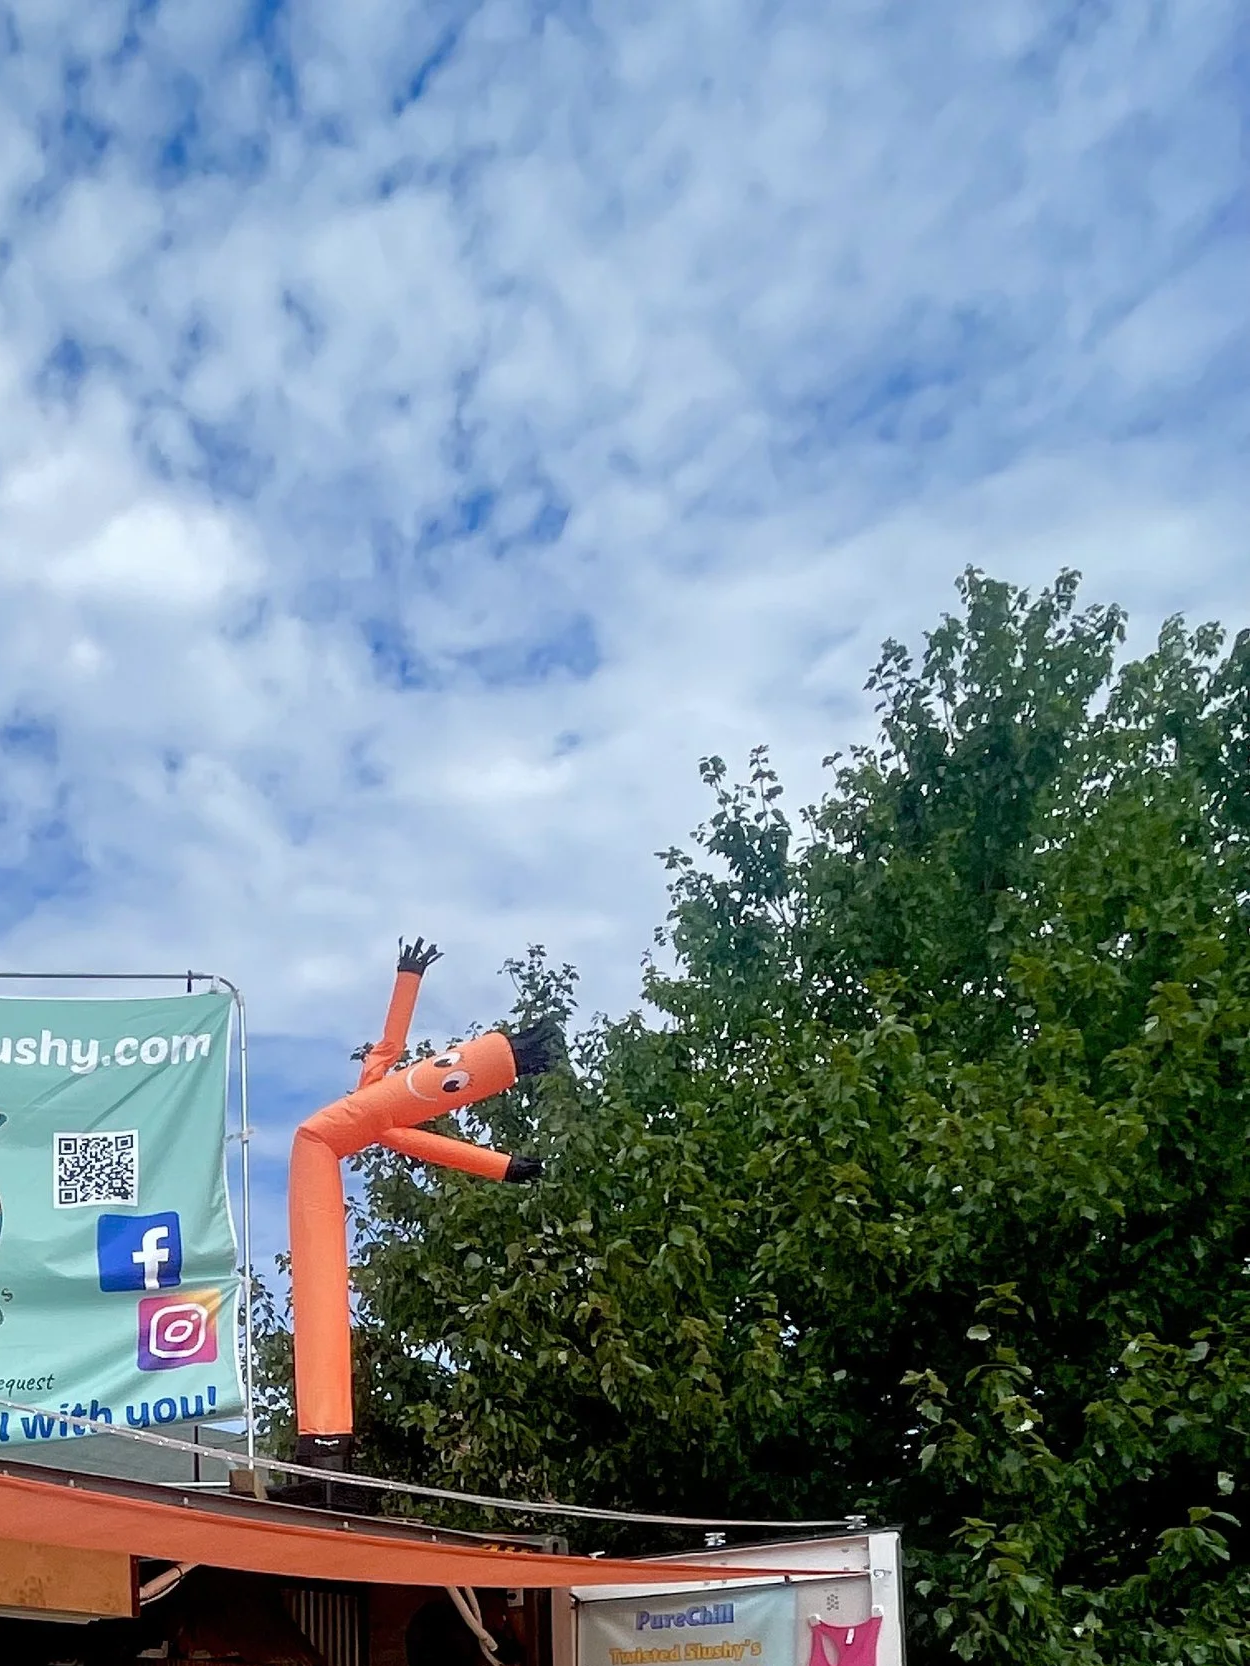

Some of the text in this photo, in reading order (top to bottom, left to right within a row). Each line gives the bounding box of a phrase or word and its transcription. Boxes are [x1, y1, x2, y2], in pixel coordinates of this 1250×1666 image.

[20, 1400, 112, 1438] with
[125, 1384, 218, 1430] you!
[635, 1602, 735, 1631] PureChill
[608, 1638, 762, 1666] Twisted Slushy's
